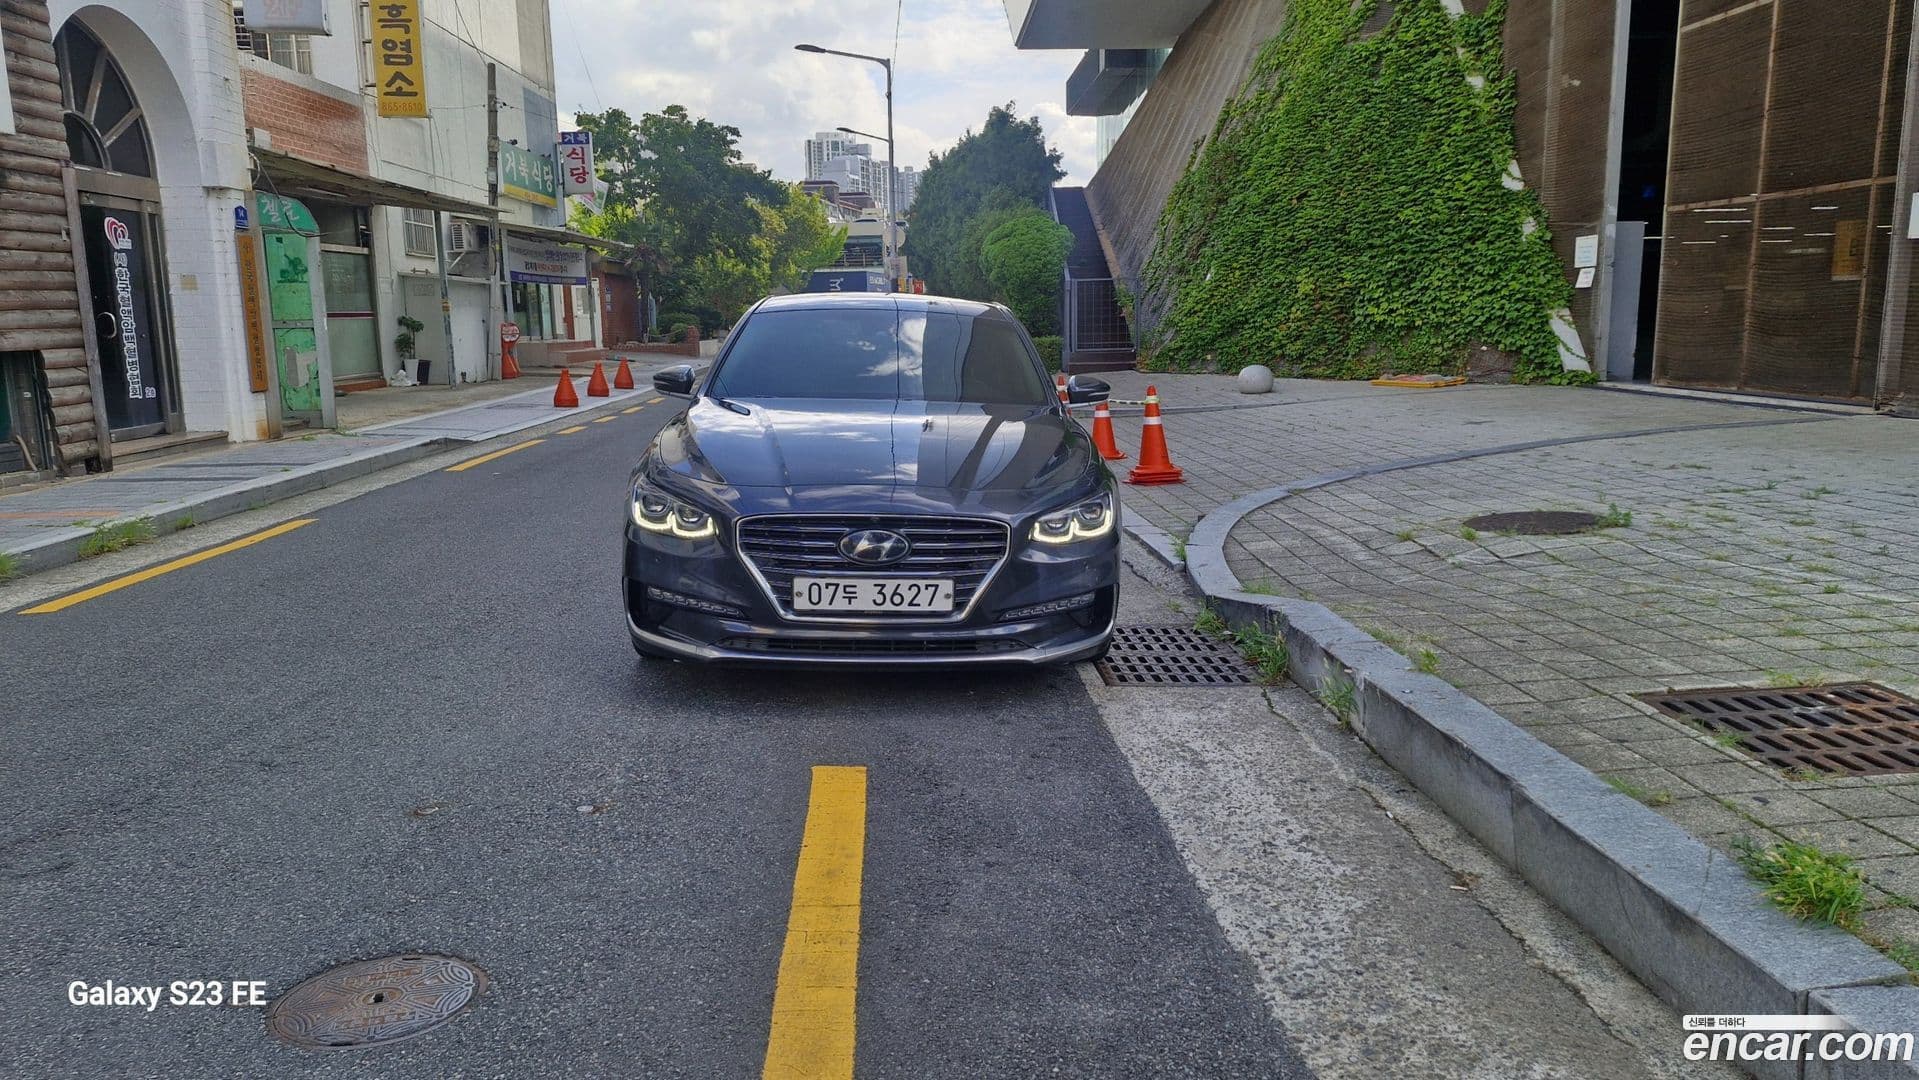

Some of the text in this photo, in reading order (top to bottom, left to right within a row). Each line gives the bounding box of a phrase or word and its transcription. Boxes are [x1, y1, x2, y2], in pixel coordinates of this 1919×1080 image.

[378, 4, 418, 97] 흑염소
[505, 150, 554, 193] 거북식당
[566, 146, 589, 184] 식당
[808, 582, 940, 607] 07두 3627
